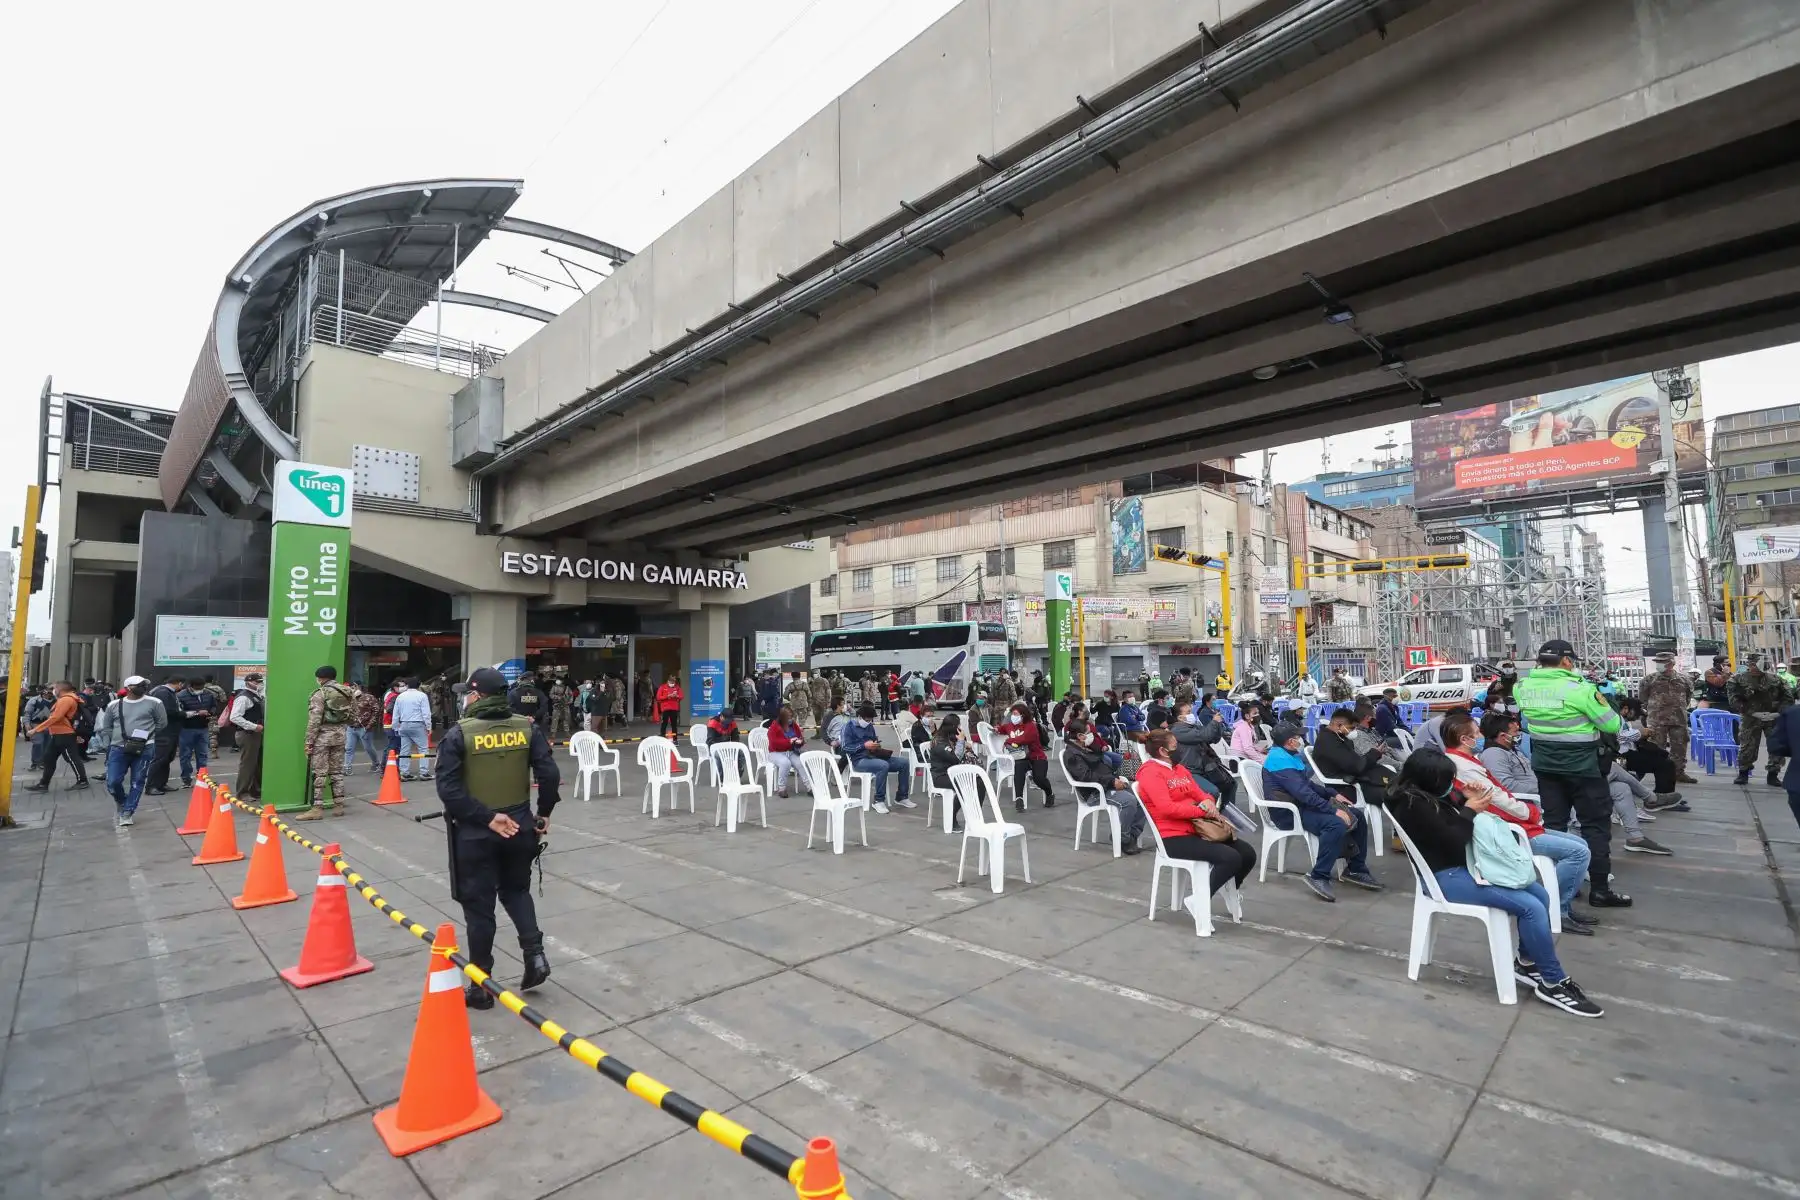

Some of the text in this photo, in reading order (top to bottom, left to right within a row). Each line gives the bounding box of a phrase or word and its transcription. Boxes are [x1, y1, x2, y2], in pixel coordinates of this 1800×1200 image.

[1473, 473, 1507, 483] nuestros
[1526, 468, 1537, 476] de
[1564, 459, 1601, 471] Agentes
[1602, 456, 1621, 466] BCP
[1483, 466, 1507, 475] dinero
[1516, 462, 1535, 471] todo
[1536, 459, 1544, 467] el
[327, 494, 340, 514] 1
[502, 551, 750, 590] ESTACION GAMARRA
[313, 542, 338, 636] de Lima
[284, 566, 309, 635] Metro
[1065, 640, 1072, 652] de
[1410, 650, 1427, 666] 14
[1416, 689, 1464, 700] POLICIA
[474, 731, 527, 750] POLICIA
